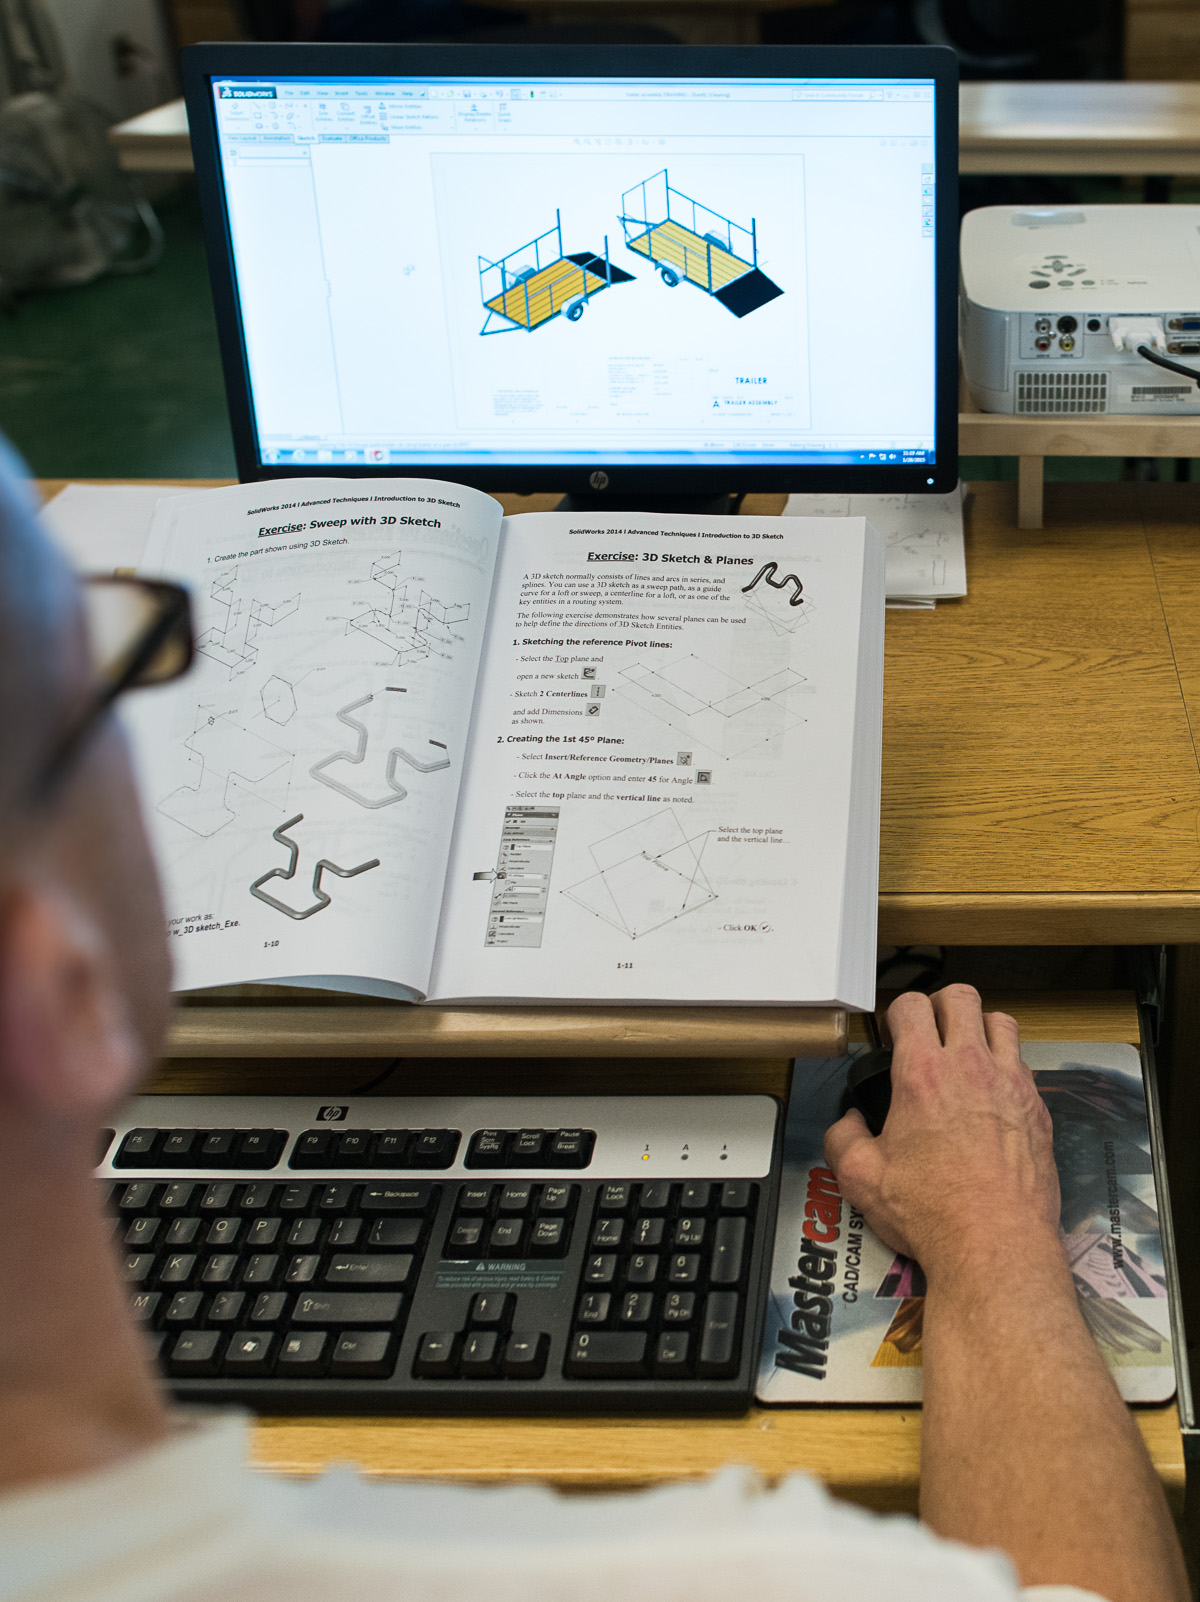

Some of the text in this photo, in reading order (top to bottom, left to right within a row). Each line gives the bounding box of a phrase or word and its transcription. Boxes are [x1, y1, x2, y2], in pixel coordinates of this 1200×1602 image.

[246, 505, 280, 515] SolidWorks
[300, 498, 332, 507] Advanced
[437, 498, 461, 508] Sketch
[257, 515, 441, 538] Exercise: Sweep with 3D Sketch
[659, 530, 697, 538] Techniques
[213, 553, 237, 562] Create
[249, 547, 264, 557] part
[264, 545, 288, 553] shown
[288, 542, 309, 550] using
[309, 539, 321, 547] 3D
[321, 537, 349, 546] Sketch.
[586, 551, 754, 565] Exercise: 3D Sketch & Planes
[530, 611, 565, 620] following
[593, 612, 640, 620] demonstrates
[682, 615, 705, 623] planes
[521, 637, 564, 646] Sketching
[581, 638, 624, 646] reference
[624, 639, 648, 647] Pivot
[649, 640, 673, 648] lines:
[496, 735, 505, 743] 2.
[506, 734, 544, 743] Creating
[596, 736, 625, 744] Plane:
[544, 753, 608, 762] Insert/Reference
[608, 755, 674, 765] Geometry/Planes
[717, 825, 739, 833] Select
[739, 826, 751, 834] the
[764, 827, 784, 836] plane
[184, 913, 202, 923] work
[195, 919, 241, 932] sketch_Exe.
[263, 939, 280, 948] 1-10
[345, 1137, 360, 1145] F10
[519, 1139, 536, 1147] Lock
[384, 1190, 419, 1198] Backspace
[466, 1190, 488, 1198] Insert
[1104, 1140, 1124, 1270] www.mastercam.com
[215, 1220, 229, 1232] O
[539, 1222, 558, 1231] Page
[601, 1221, 610, 1231] 7
[641, 1220, 650, 1230] 8
[681, 1220, 691, 1231] 9
[169, 1258, 182, 1269] K
[488, 1263, 526, 1272] WARNING
[775, 1167, 842, 1380] Mastercam
[843, 1236, 862, 1303] CAD/CAM
[578, 1334, 589, 1347] 0
